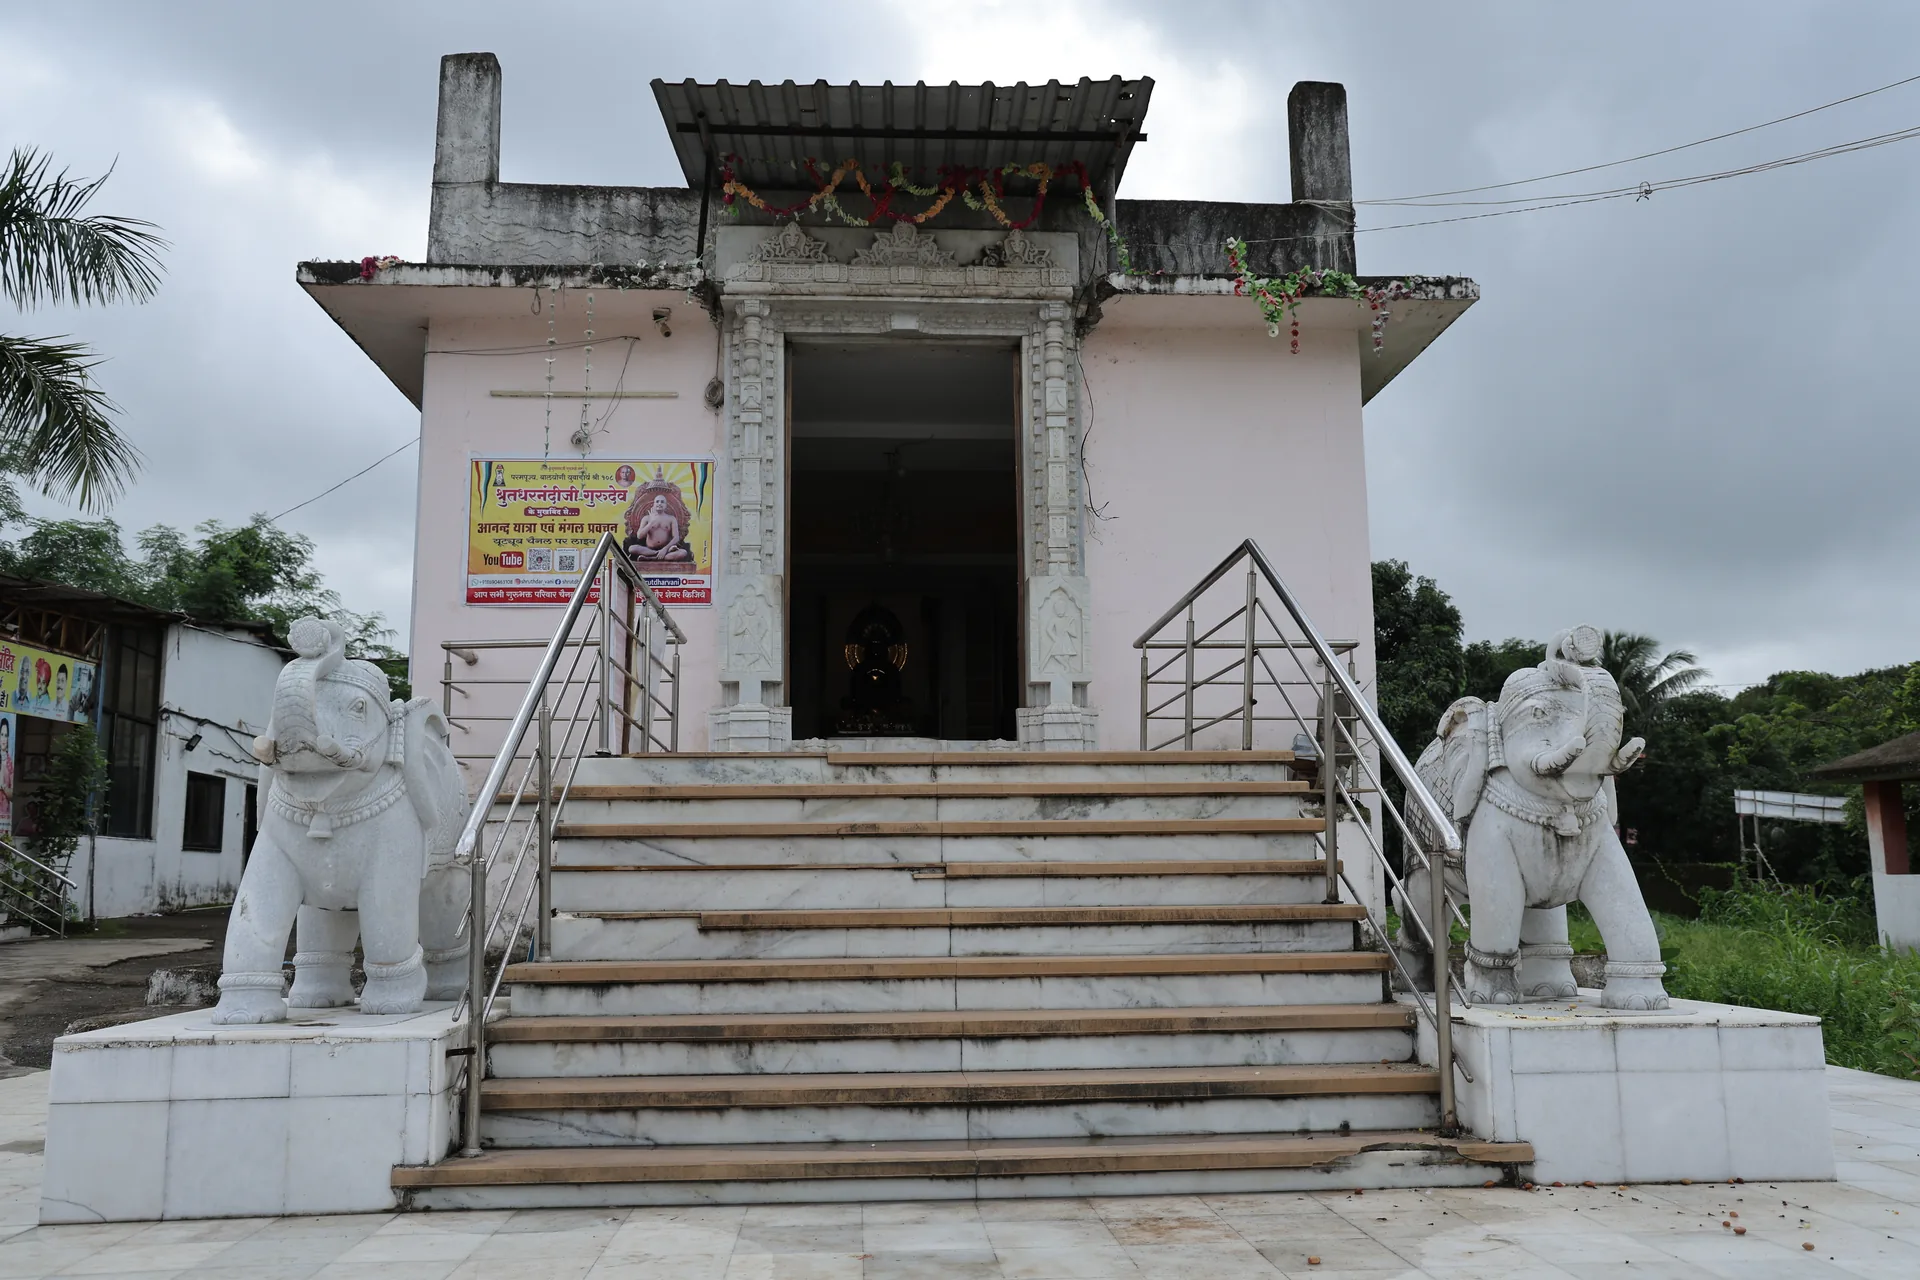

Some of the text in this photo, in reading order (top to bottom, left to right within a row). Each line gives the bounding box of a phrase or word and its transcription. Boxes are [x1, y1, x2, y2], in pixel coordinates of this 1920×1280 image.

[528, 507, 535, 515] के
[477, 518, 618, 534] आनन्द यात्रा एवं मंगल प्रवचन
[526, 536, 552, 545] चैनल
[571, 538, 596, 546] लाइव
[645, 578, 680, 586] rutdharvani
[490, 589, 504, 598] सभी
[535, 589, 557, 598] परिवार
